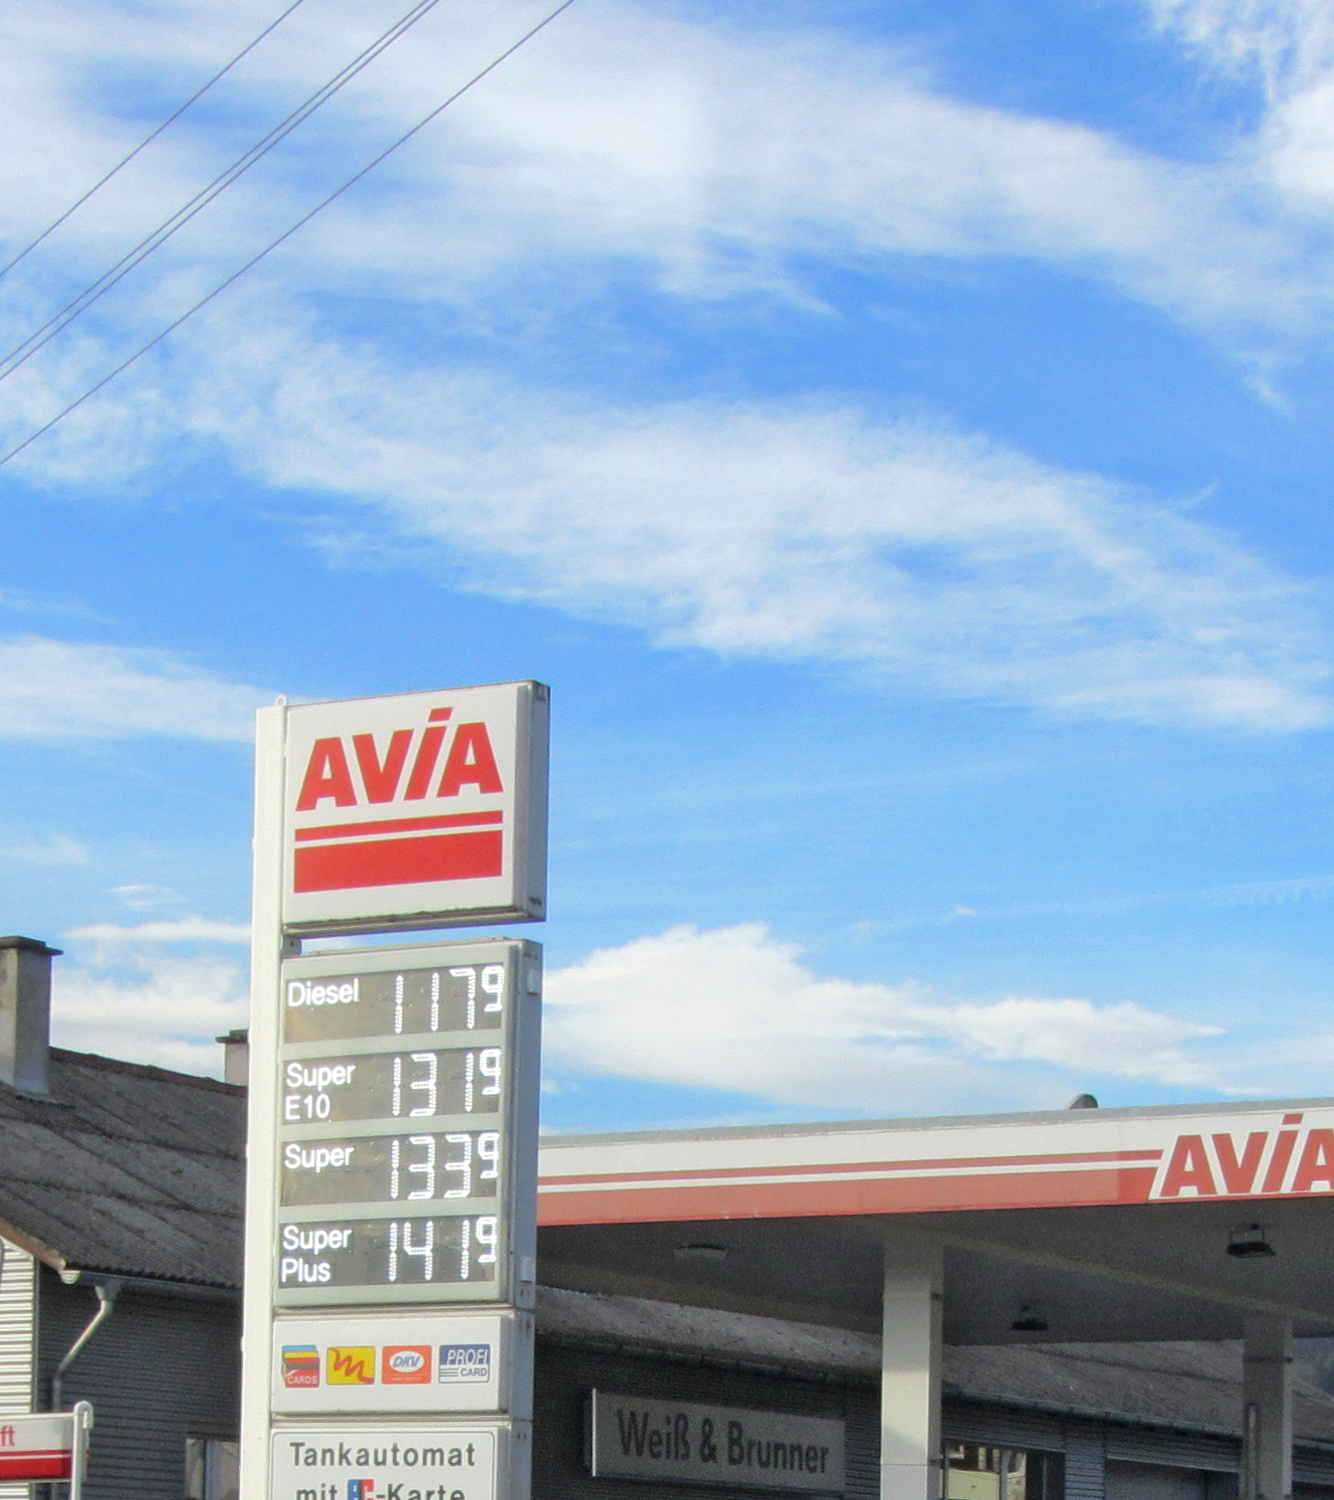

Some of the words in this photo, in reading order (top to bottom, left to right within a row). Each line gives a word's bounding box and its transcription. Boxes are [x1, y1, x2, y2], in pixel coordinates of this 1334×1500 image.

[295, 706, 504, 812] AVIA
[287, 978, 360, 1007] Diesel
[286, 1063, 356, 1091] Super
[285, 1095, 331, 1121] E10
[284, 1144, 354, 1173] Super
[282, 1225, 352, 1254] Super
[281, 1258, 331, 1283] Plus
[392, 1355, 421, 1367] DKV
[447, 1348, 489, 1365] PROFI
[287, 1375, 318, 1385] CARDS
[460, 1367, 488, 1377] CARD
[289, 1441, 476, 1467] Tankautomat
[618, 1408, 690, 1461] Weiß
[700, 1418, 717, 1464] &
[728, 1420, 829, 1474] Brunner
